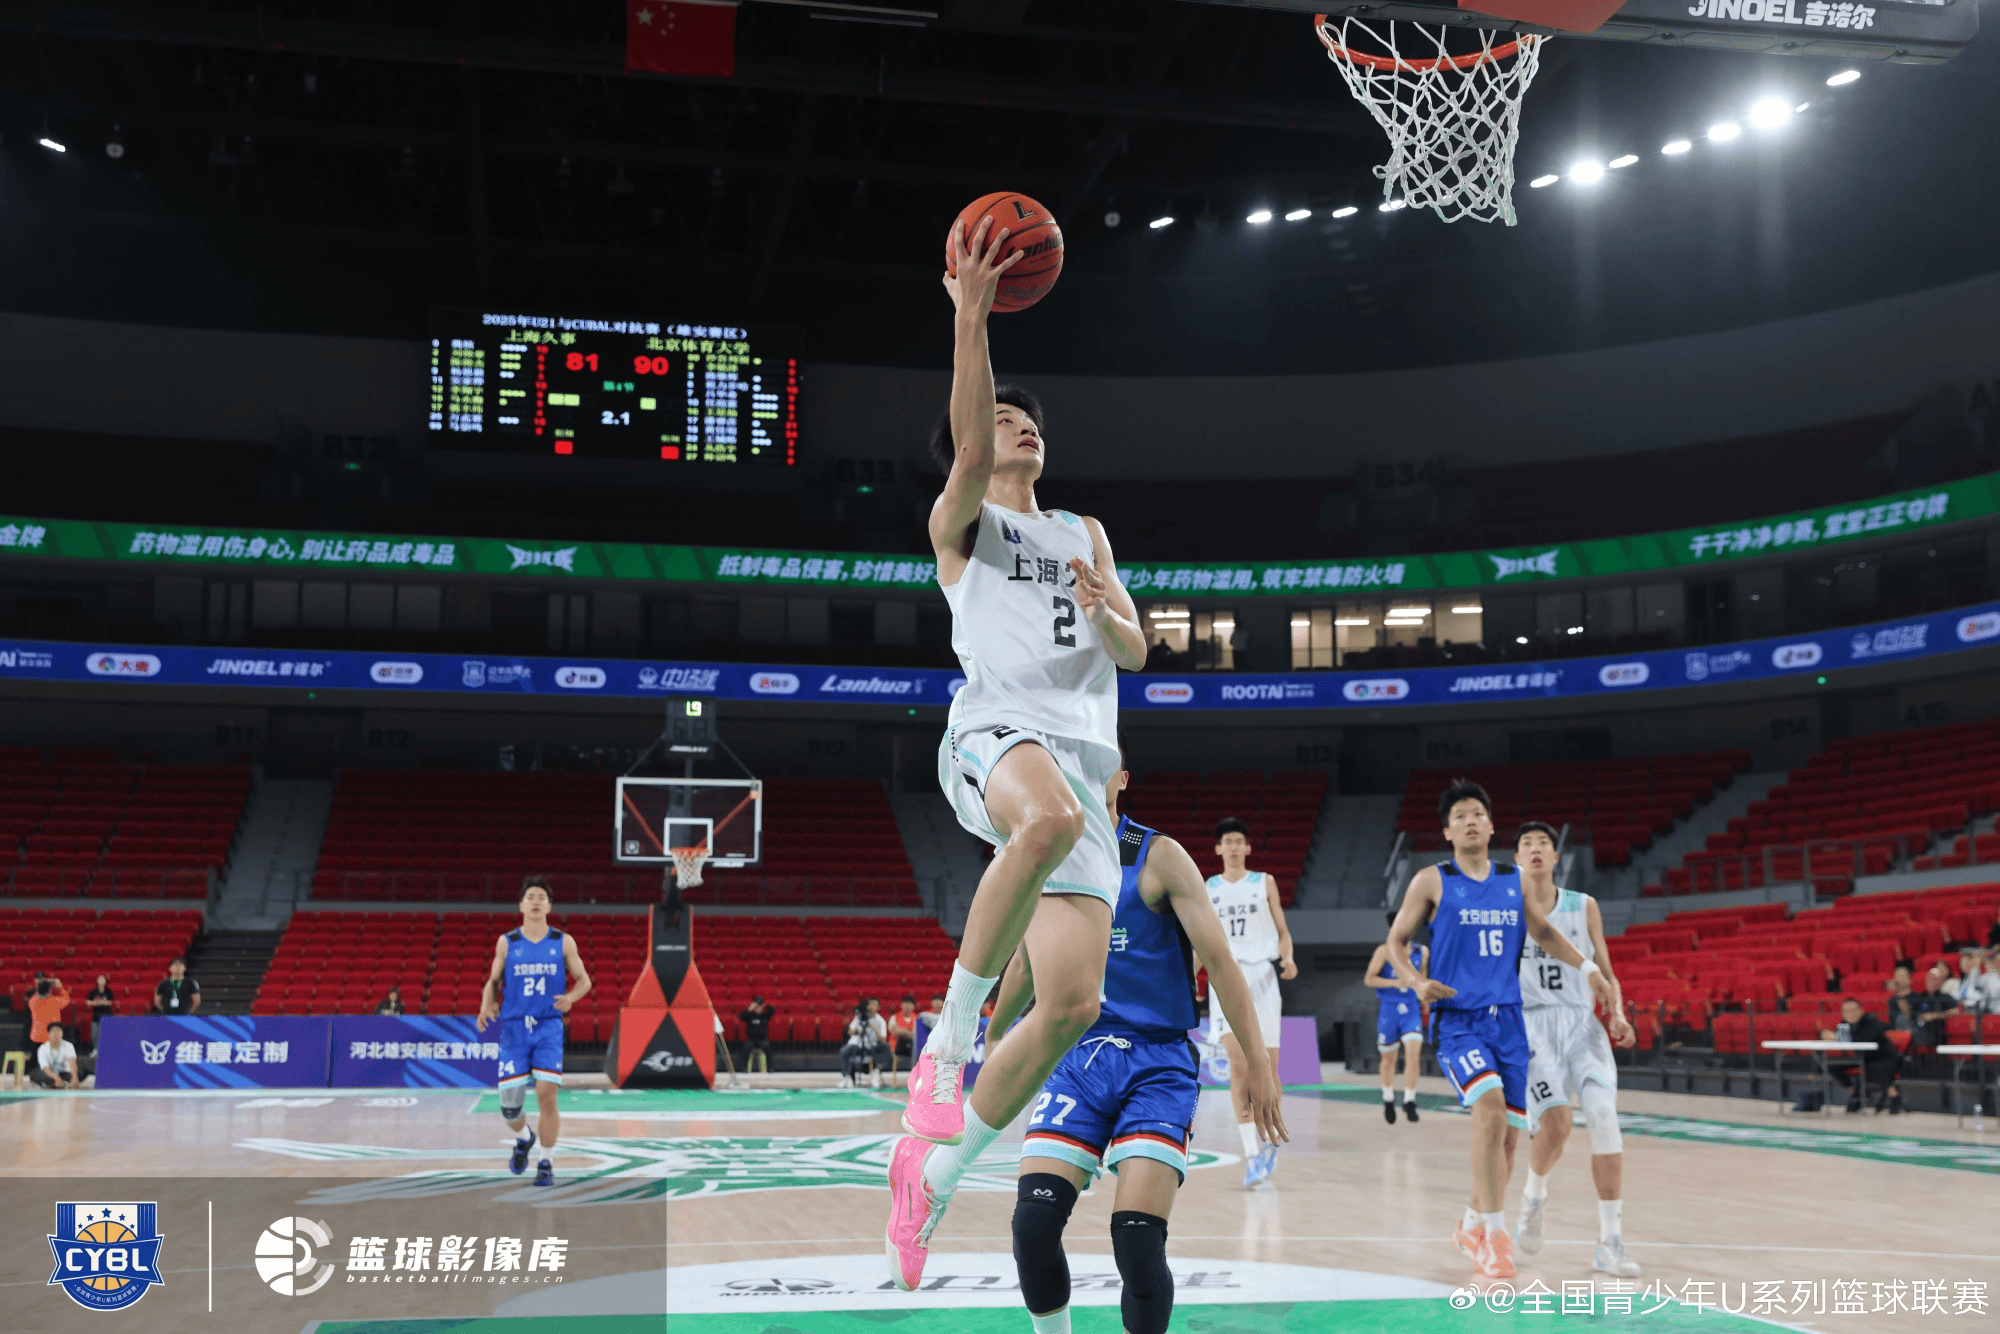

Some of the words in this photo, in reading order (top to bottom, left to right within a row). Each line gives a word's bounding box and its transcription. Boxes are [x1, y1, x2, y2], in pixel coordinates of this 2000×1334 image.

[566, 351, 599, 373] 81
[634, 355, 669, 376] 90
[601, 410, 631, 426] 2.1
[1053, 595, 1076, 648] 2
[820, 675, 912, 694] Lanhua
[1230, 918, 1246, 937] 17
[1458, 908, 1519, 926] 北京体育大学
[1478, 929, 1504, 957] 16
[523, 977, 546, 997] 24
[1538, 964, 1563, 989] 12
[174, 1041, 289, 1064] 维意定制
[1458, 1049, 1487, 1077] 16
[1531, 1081, 1553, 1103] 12
[1028, 1092, 1077, 1127] 27
